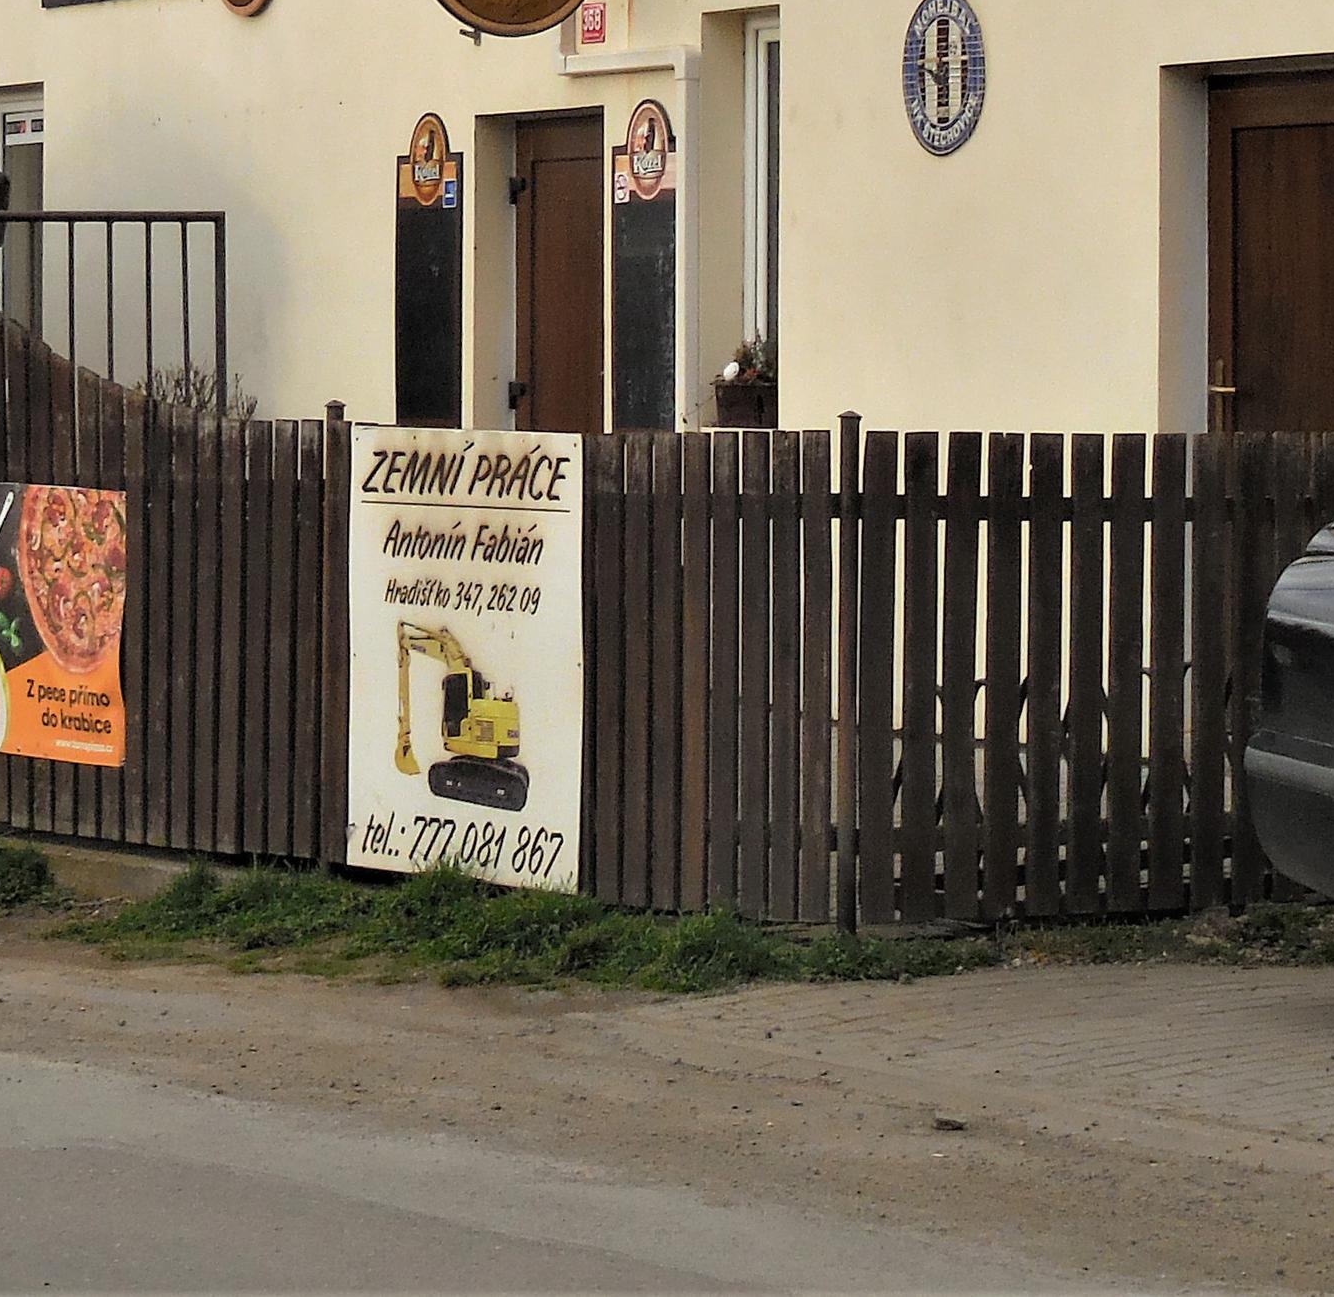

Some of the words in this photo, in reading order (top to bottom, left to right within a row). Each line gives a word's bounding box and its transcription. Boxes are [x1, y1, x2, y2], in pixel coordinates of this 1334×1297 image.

[361, 441, 475, 496] ZEMNÍ
[468, 445, 571, 501] PRÁCE
[383, 519, 467, 561] Antonín
[471, 523, 544, 566] Fabián
[454, 581, 483, 616] 347,
[487, 583, 518, 612] 262
[519, 586, 541, 615] 09
[27, 678, 35, 698] Z
[37, 684, 66, 703] pece
[69, 685, 110, 708] přímo
[41, 708, 58, 728] do
[61, 708, 112, 734] krabice
[362, 811, 406, 857] tel.:
[409, 815, 457, 863] 777
[460, 821, 507, 869] 081
[512, 825, 565, 878] 867
